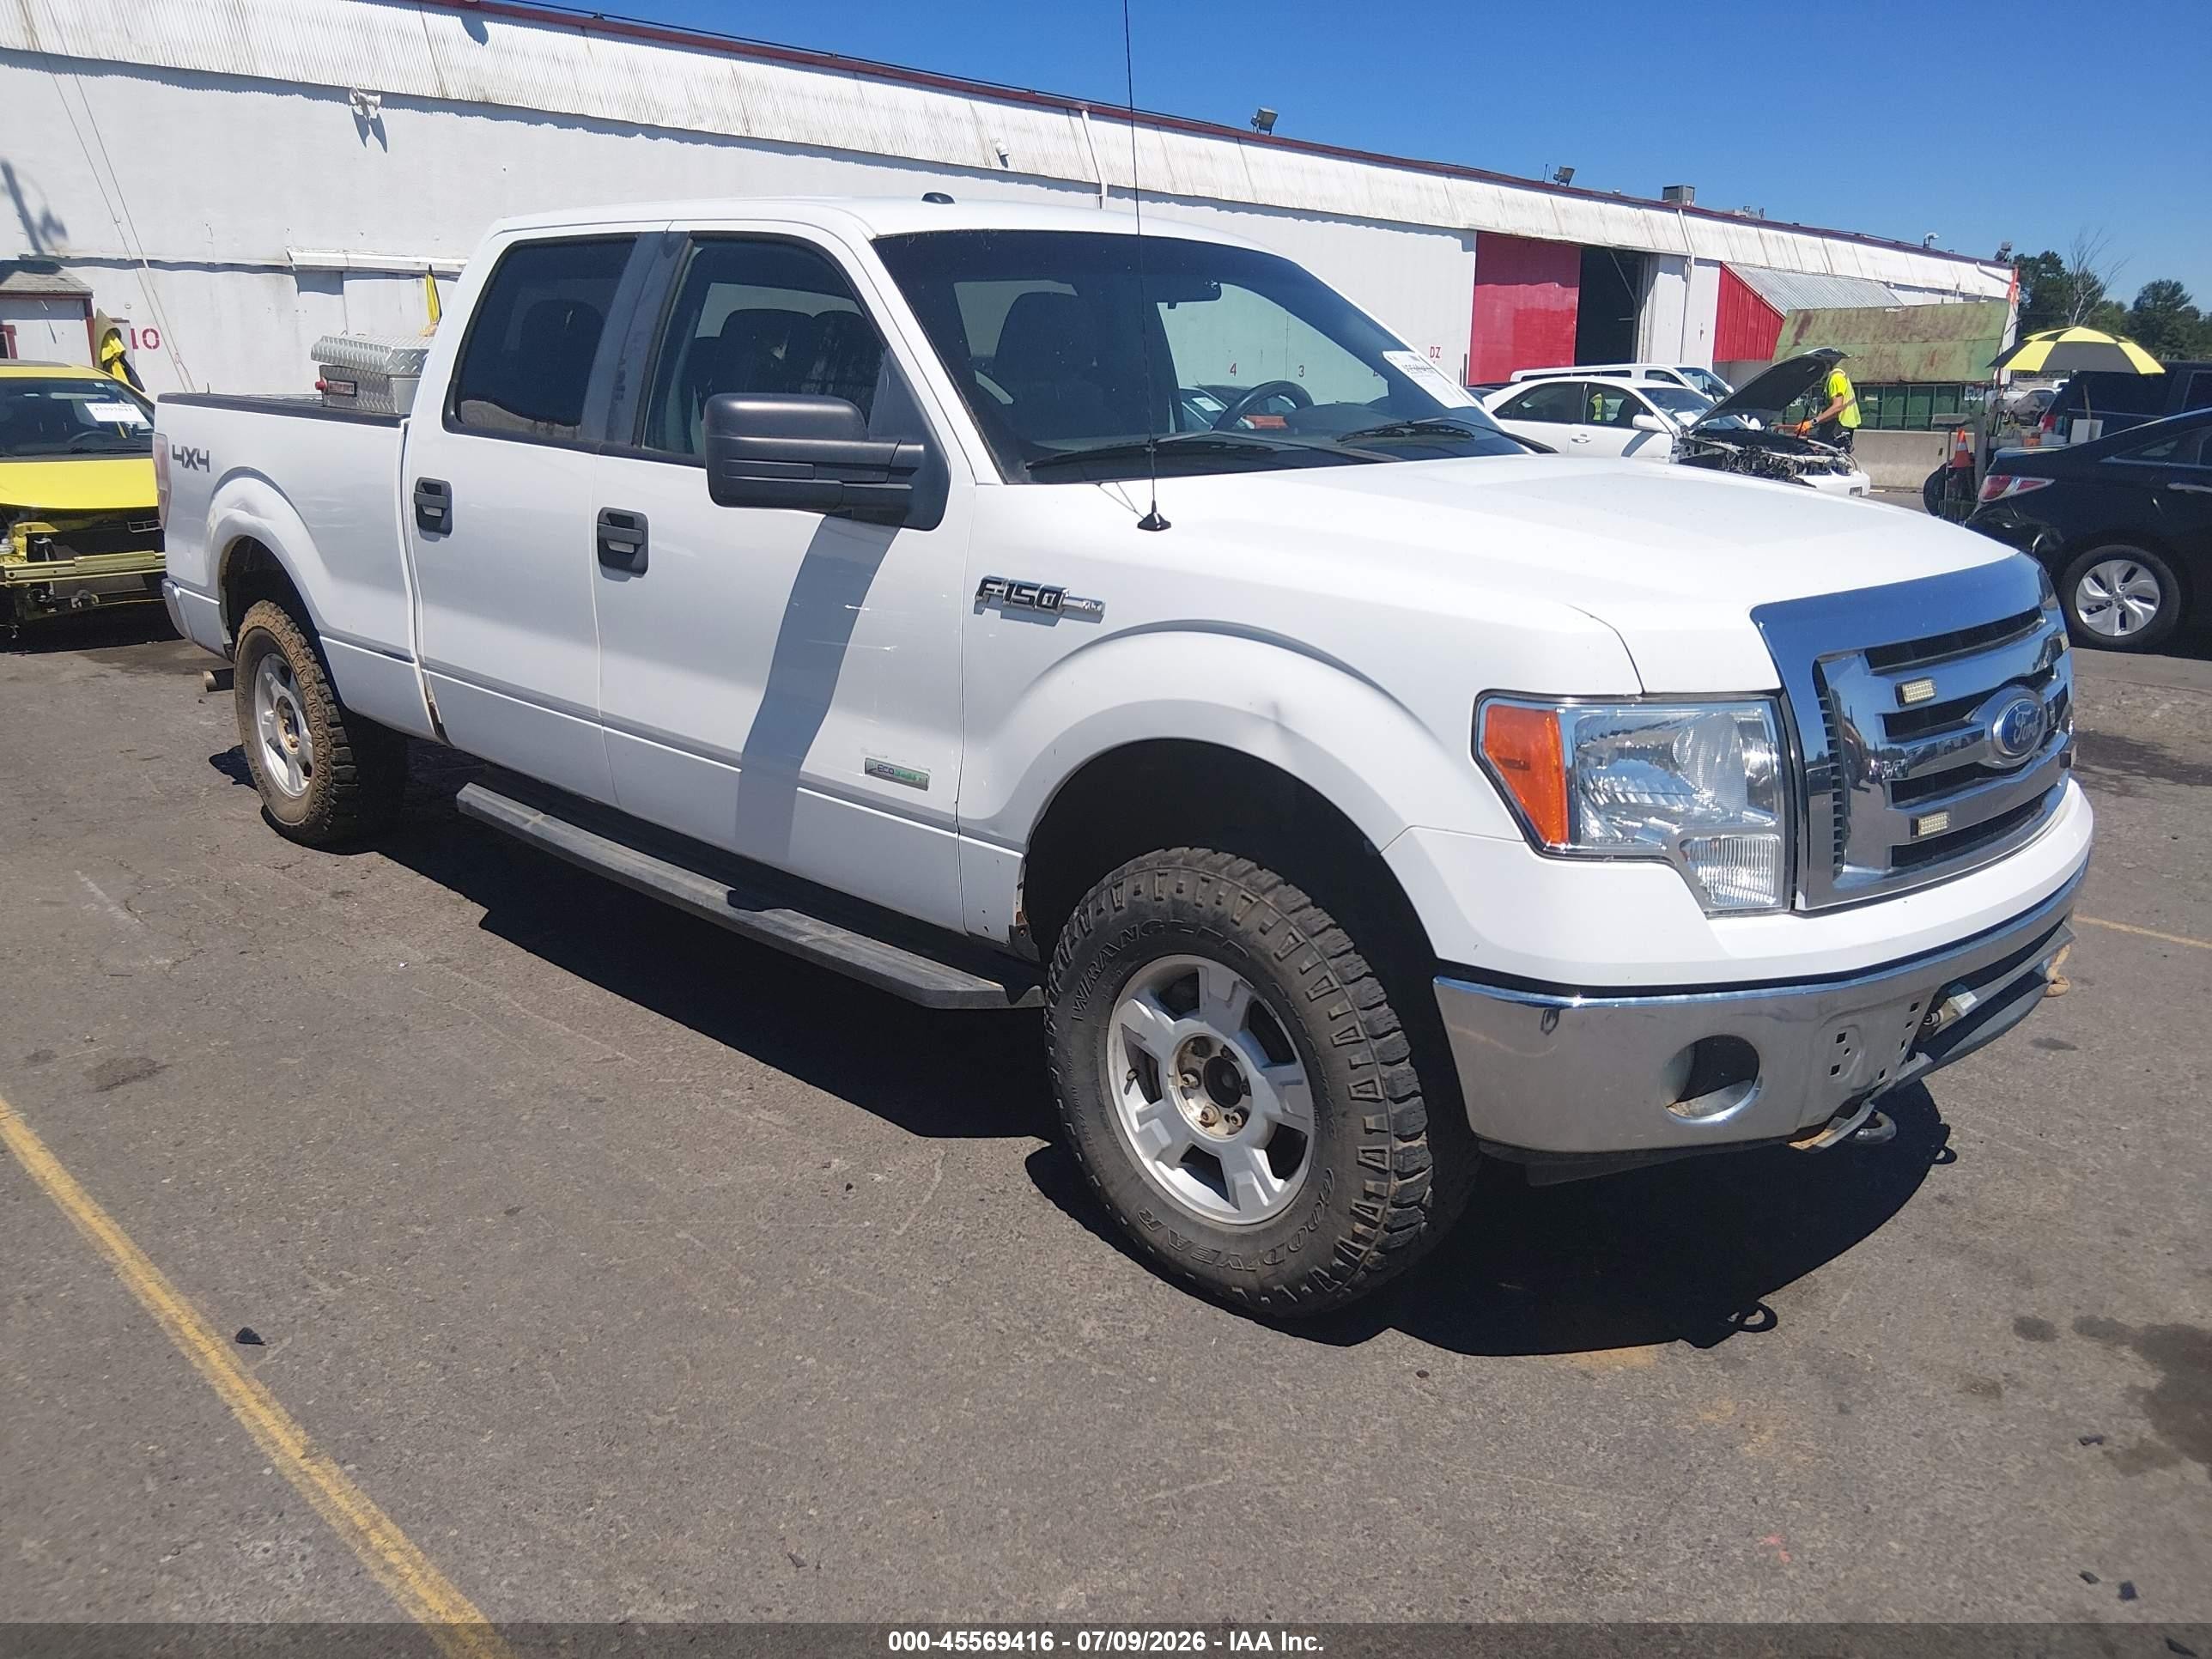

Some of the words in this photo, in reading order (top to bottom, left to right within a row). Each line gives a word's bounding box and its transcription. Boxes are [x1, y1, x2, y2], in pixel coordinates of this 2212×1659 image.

[130, 328, 160, 350] 10
[1229, 362, 1238, 377] 4
[1297, 364, 1306, 378] 3
[2013, 706, 2041, 744] Ford
[1136, 1166, 1336, 1272] GOODYEAR
